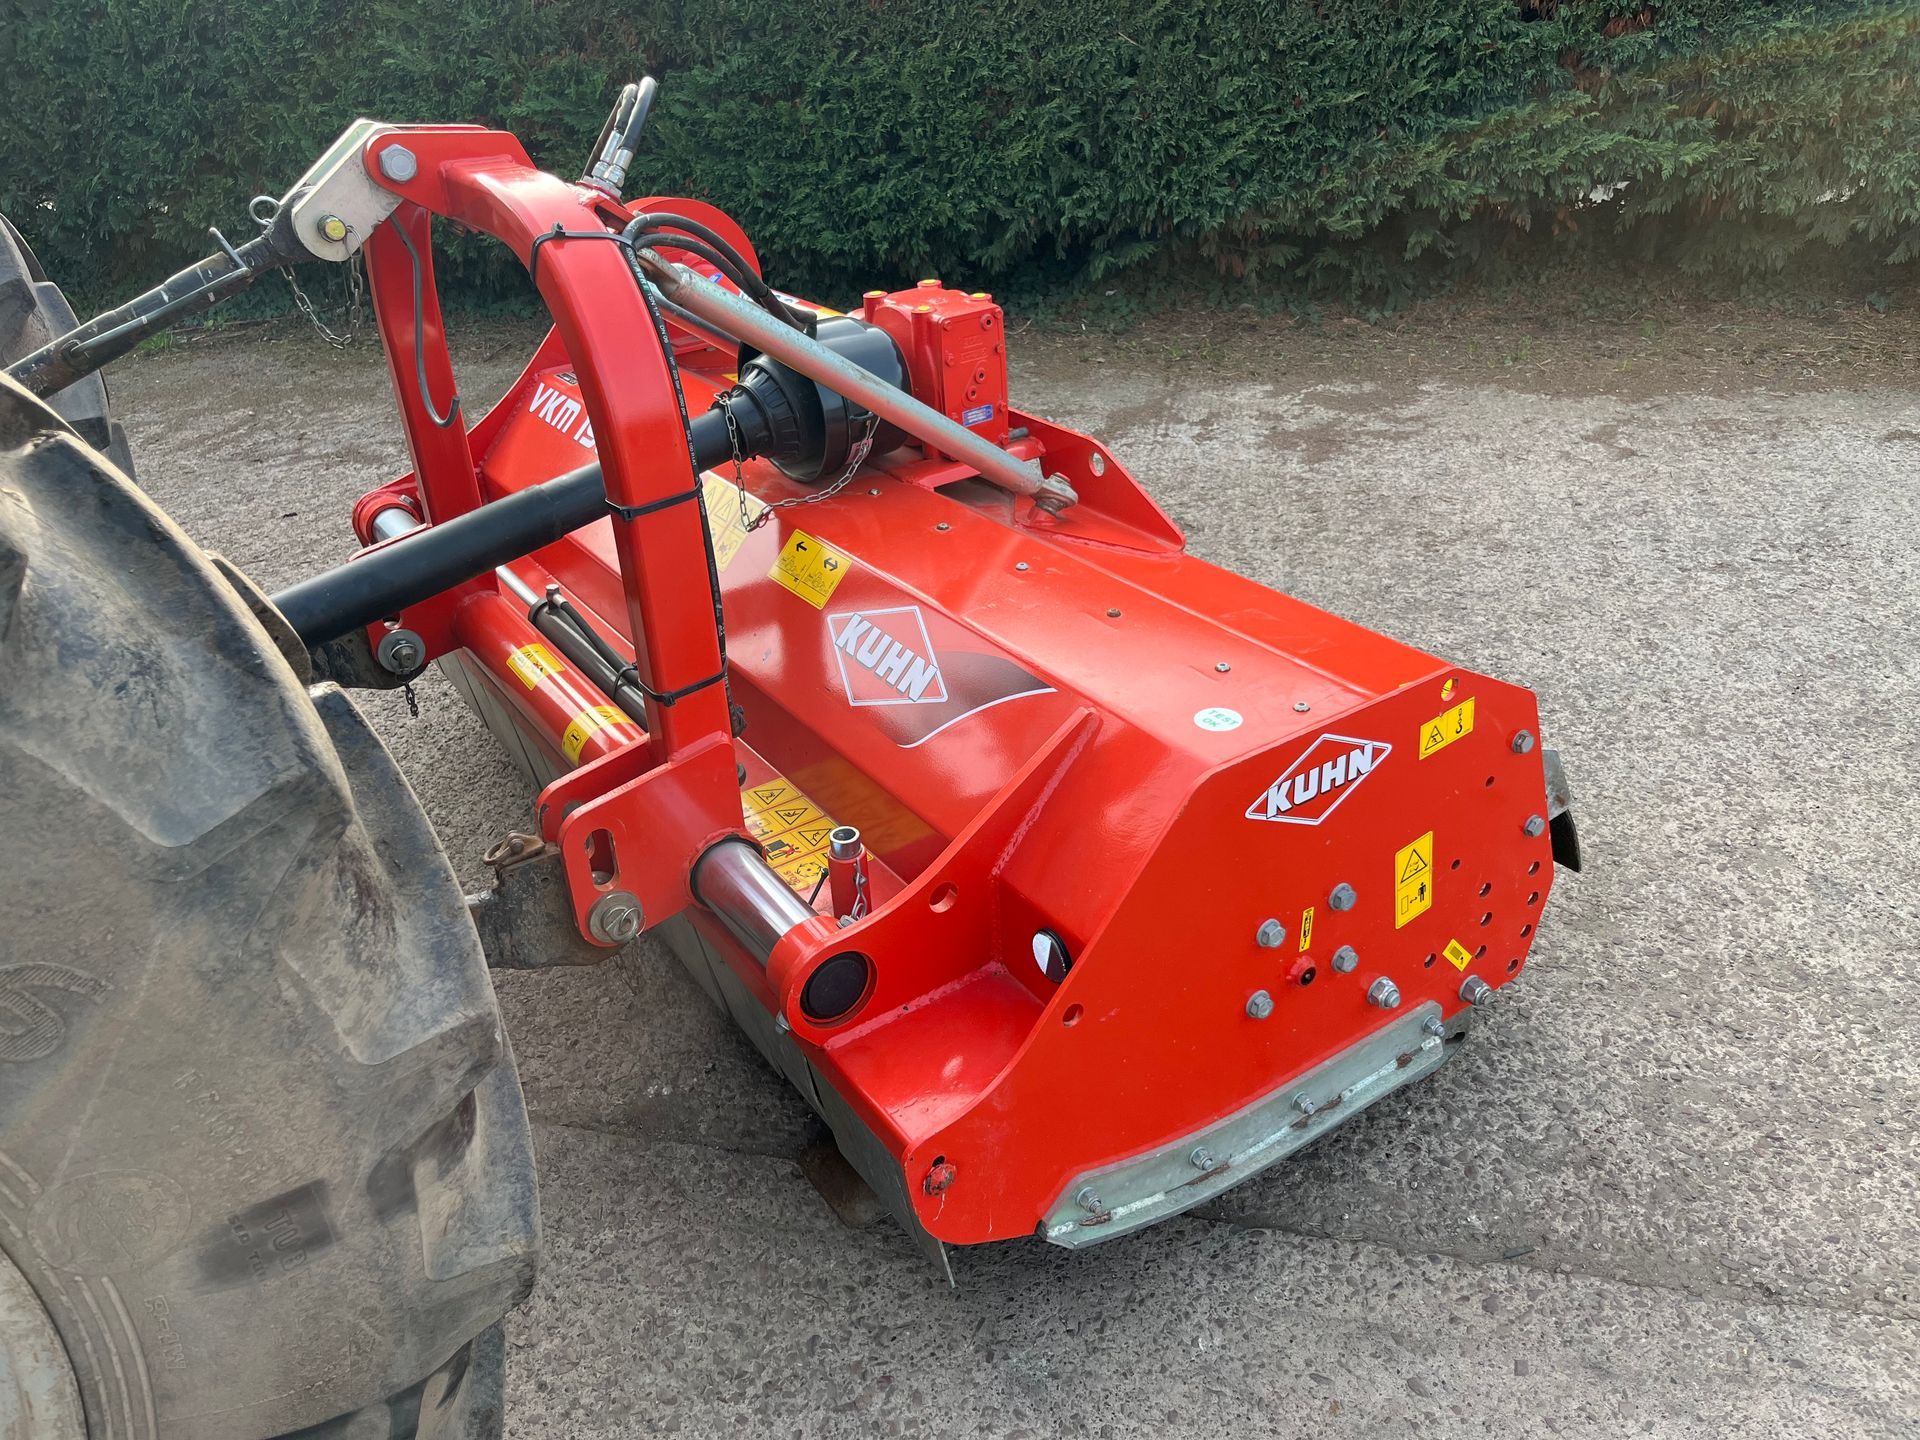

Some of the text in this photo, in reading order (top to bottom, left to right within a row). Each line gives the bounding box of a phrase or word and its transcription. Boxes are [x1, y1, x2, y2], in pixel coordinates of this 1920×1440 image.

[659, 324, 667, 336] DN
[529, 382, 582, 433] VKM
[835, 613, 938, 702] KUHN
[1202, 717, 1218, 728] OK
[1208, 709, 1240, 726] TEST
[1266, 742, 1374, 820] KUHN
